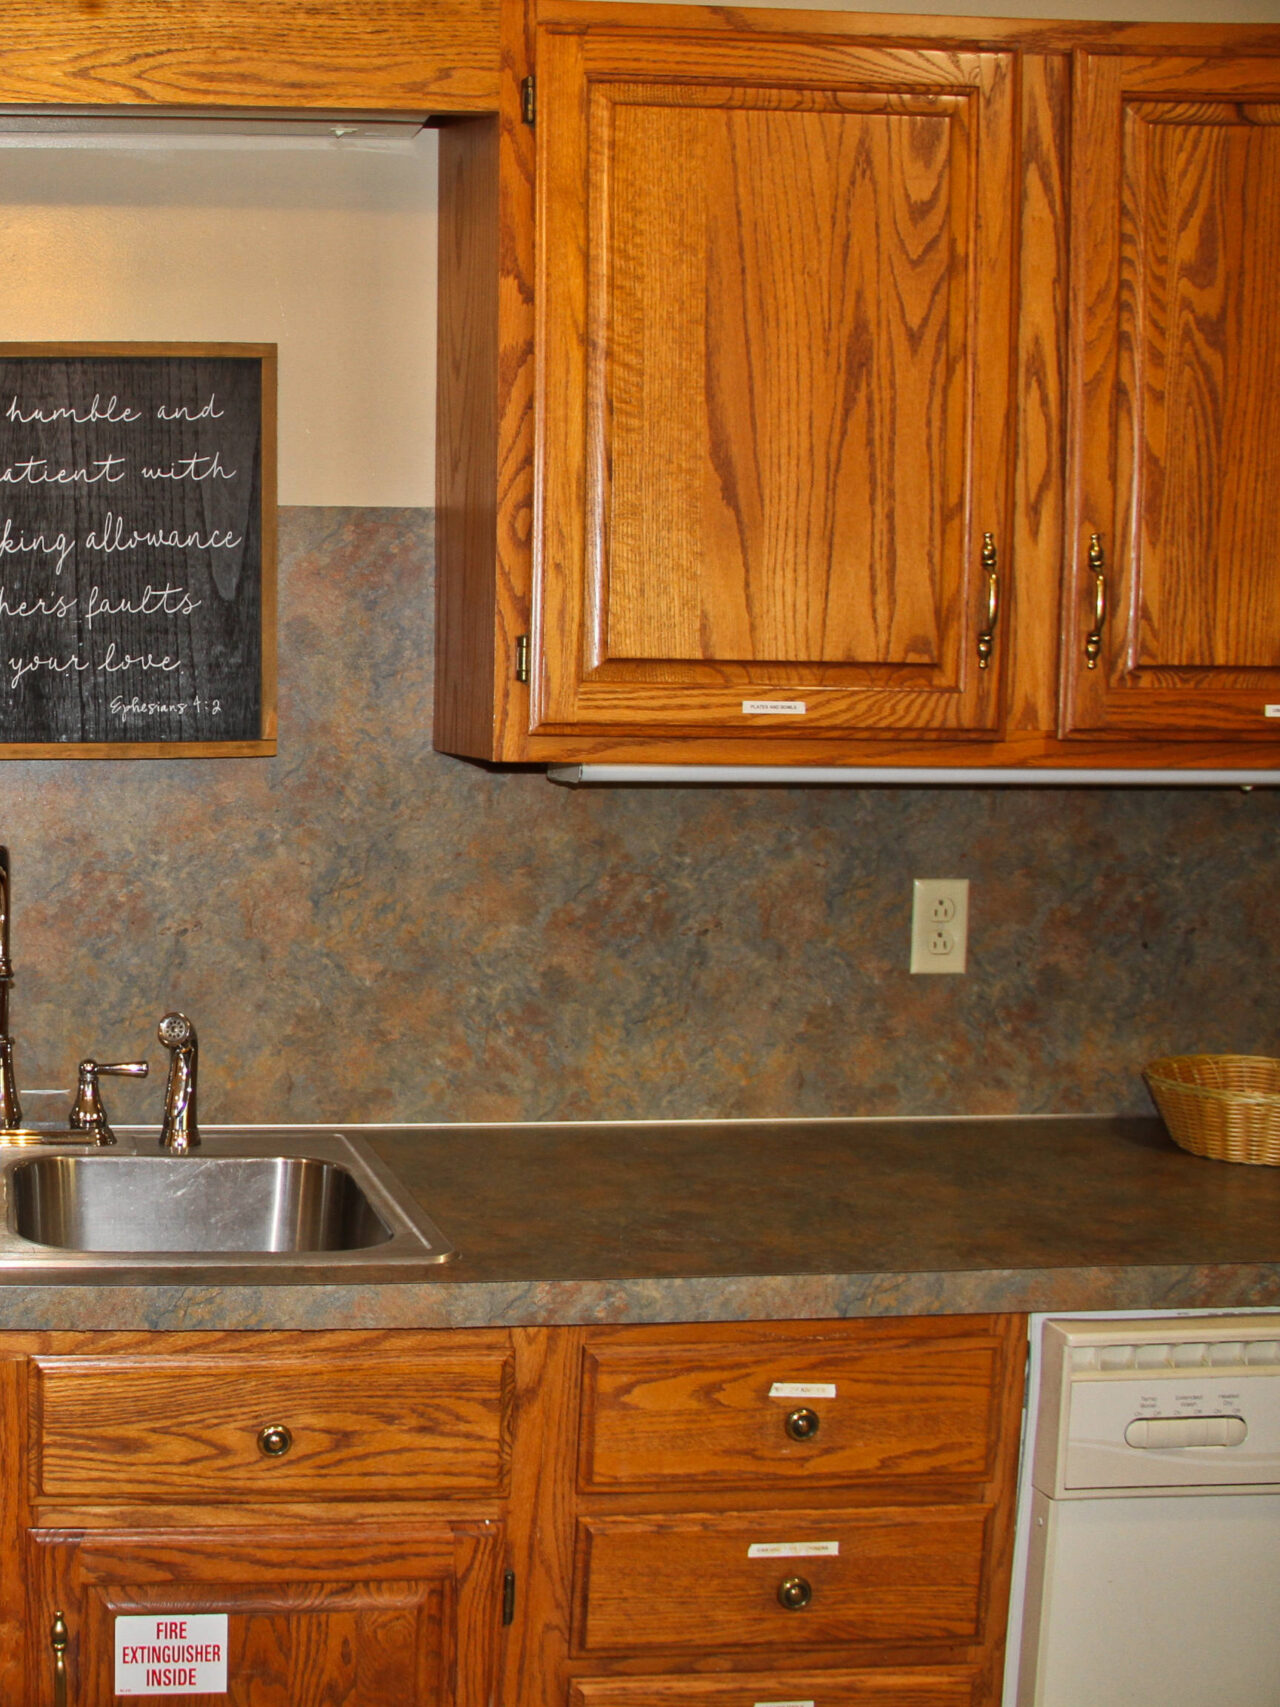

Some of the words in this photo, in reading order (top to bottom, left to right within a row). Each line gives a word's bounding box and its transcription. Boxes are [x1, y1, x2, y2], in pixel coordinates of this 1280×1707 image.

[6, 394, 141, 424] humble
[157, 394, 224, 421] and
[141, 452, 237, 481] with
[85, 512, 242, 550] allowance
[85, 583, 202, 630] faults
[9, 655, 89, 688] your
[98, 643, 184, 676] love.
[109, 695, 188, 722] Ephesians
[156, 1621, 187, 1640] FIRE
[122, 1644, 221, 1664] EXTINGUISHER
[146, 1668, 197, 1687] INSIDE
